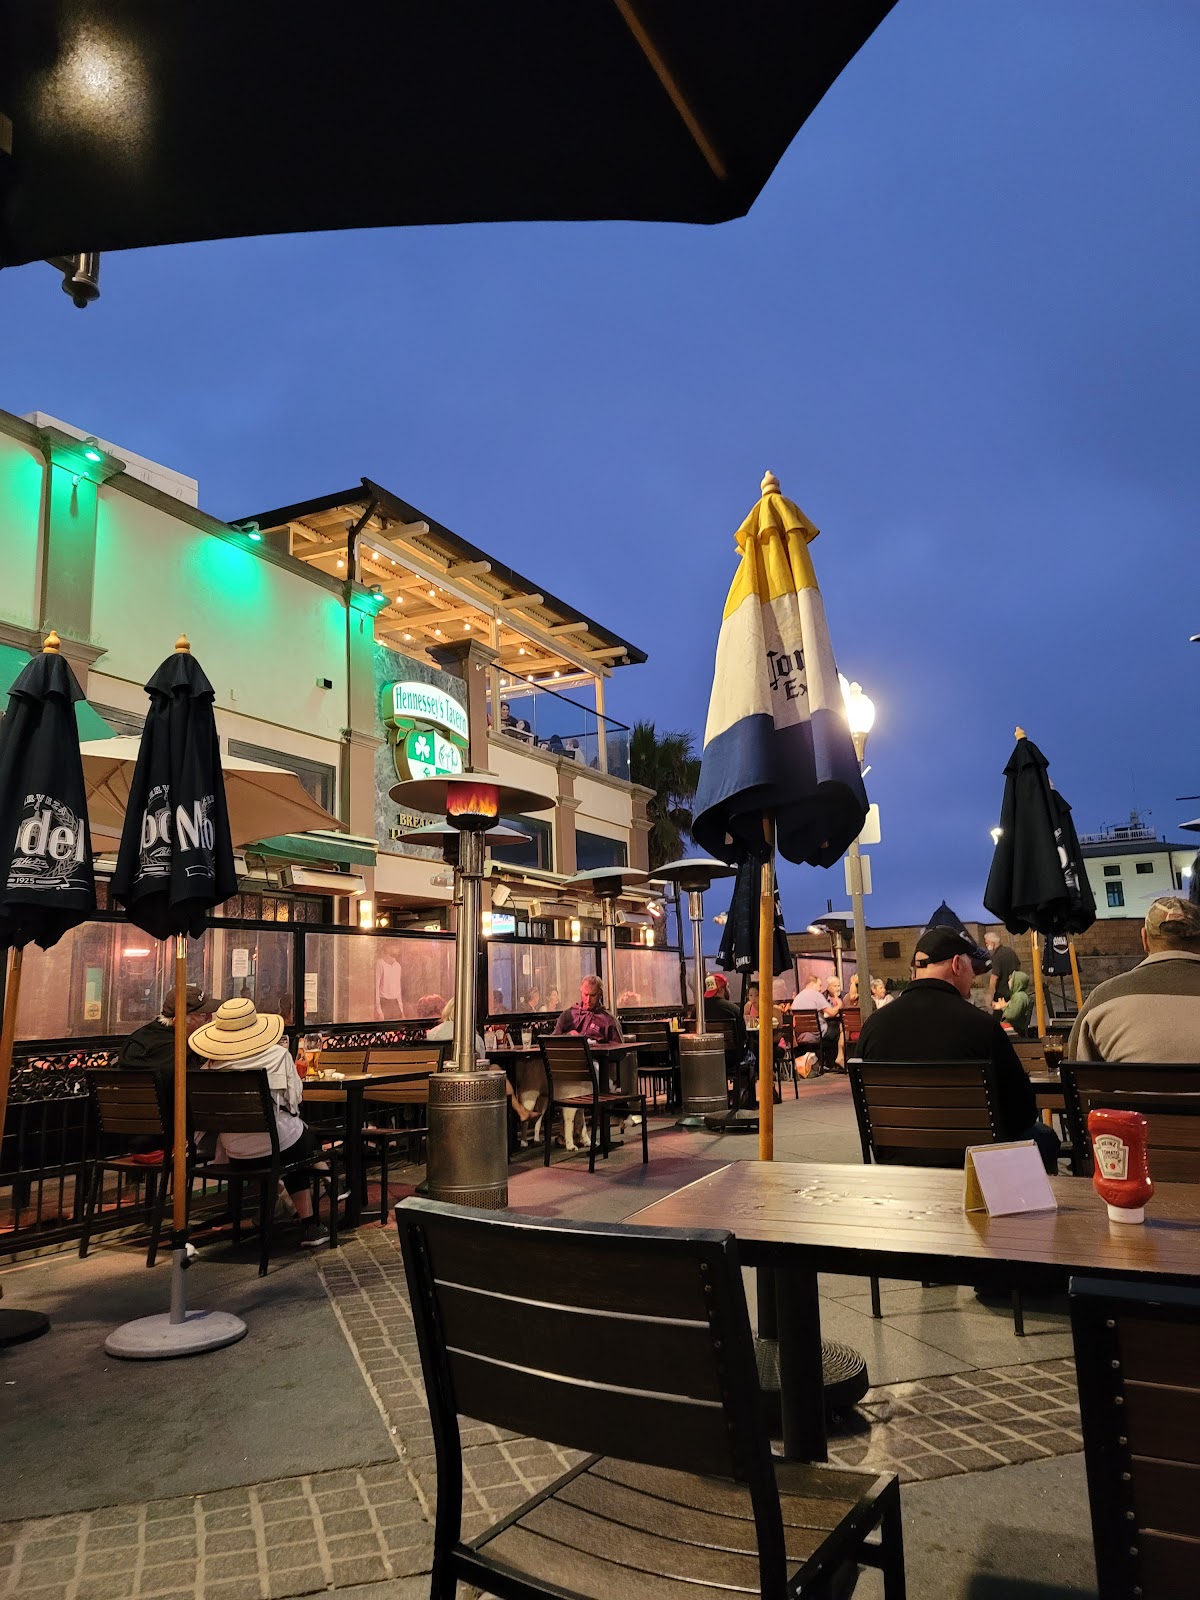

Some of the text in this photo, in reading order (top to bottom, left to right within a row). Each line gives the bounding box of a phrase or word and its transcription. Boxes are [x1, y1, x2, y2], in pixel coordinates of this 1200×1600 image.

[396, 687, 467, 735] Hennessey's Tavern
[14, 809, 85, 863] del
